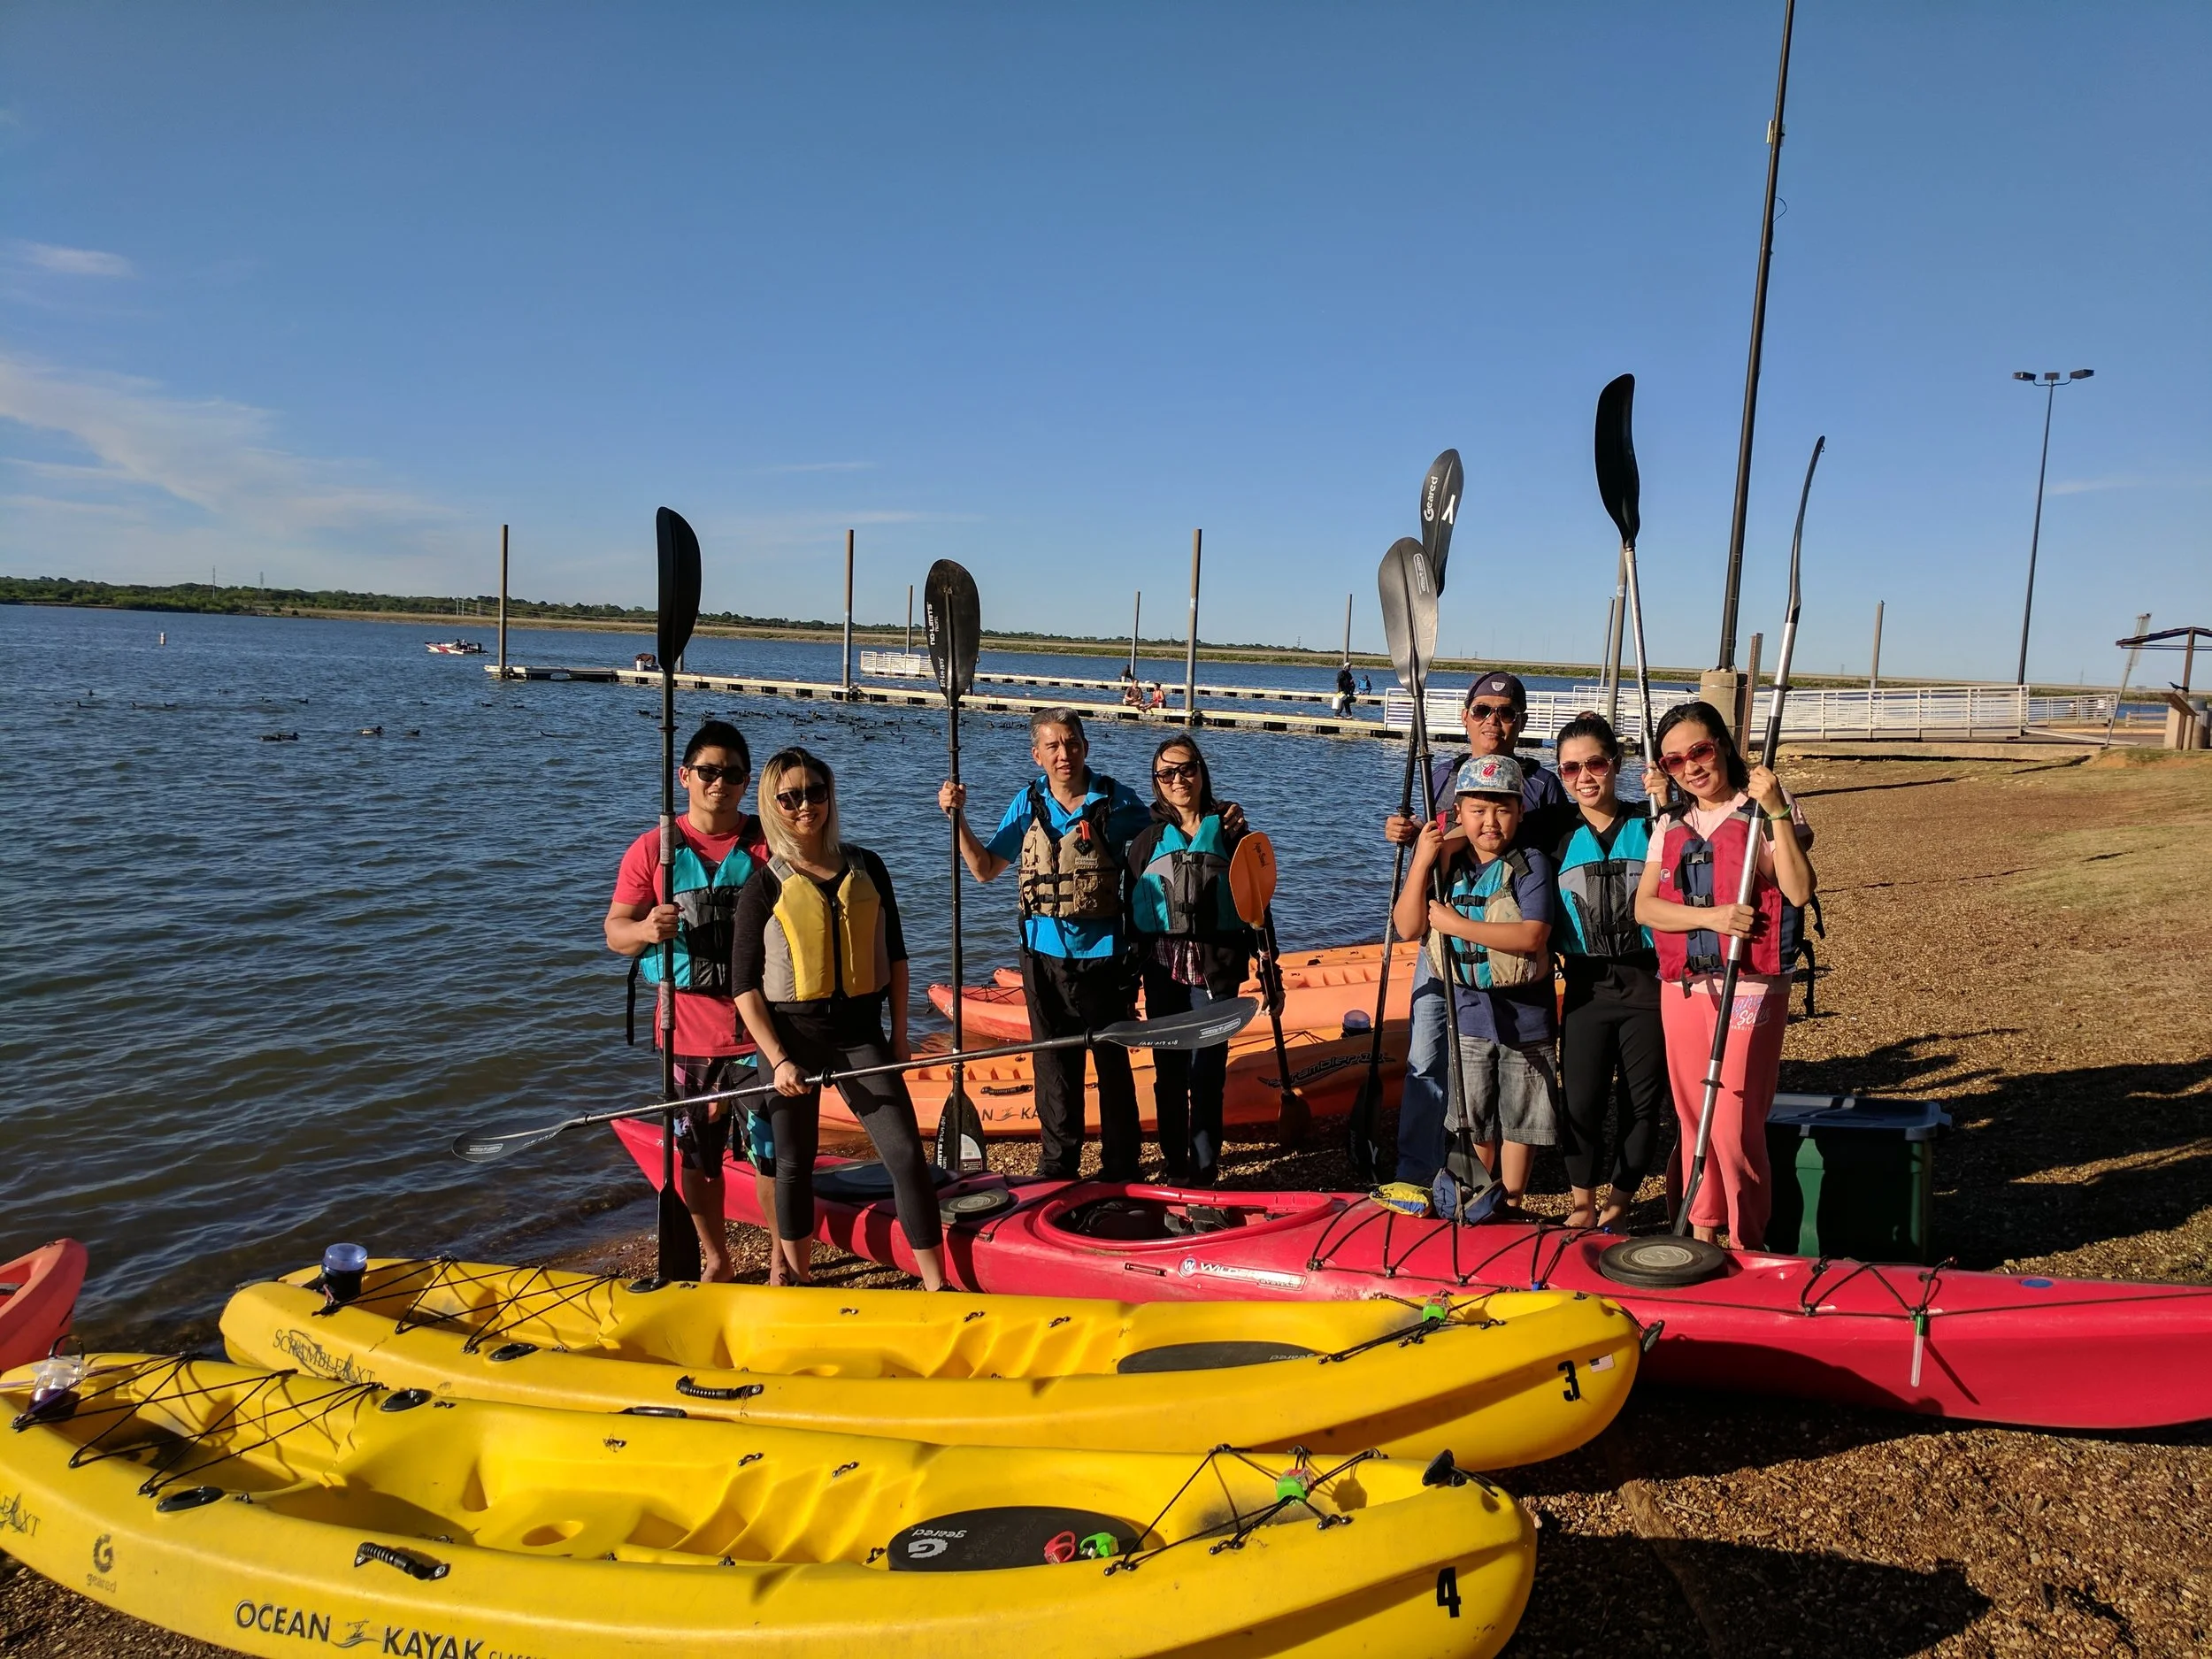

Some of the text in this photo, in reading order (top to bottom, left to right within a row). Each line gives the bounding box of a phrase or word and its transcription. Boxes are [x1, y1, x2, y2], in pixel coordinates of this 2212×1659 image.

[1424, 476, 1438, 521] Geared
[355, 1365, 375, 1384] XT
[1557, 1359, 1580, 1402] 3
[911, 1528, 968, 1540] geared
[86, 1573, 117, 1594] geared
[1436, 1565, 1462, 1618] 4
[234, 1600, 486, 1659] OCEAN KAYAK
